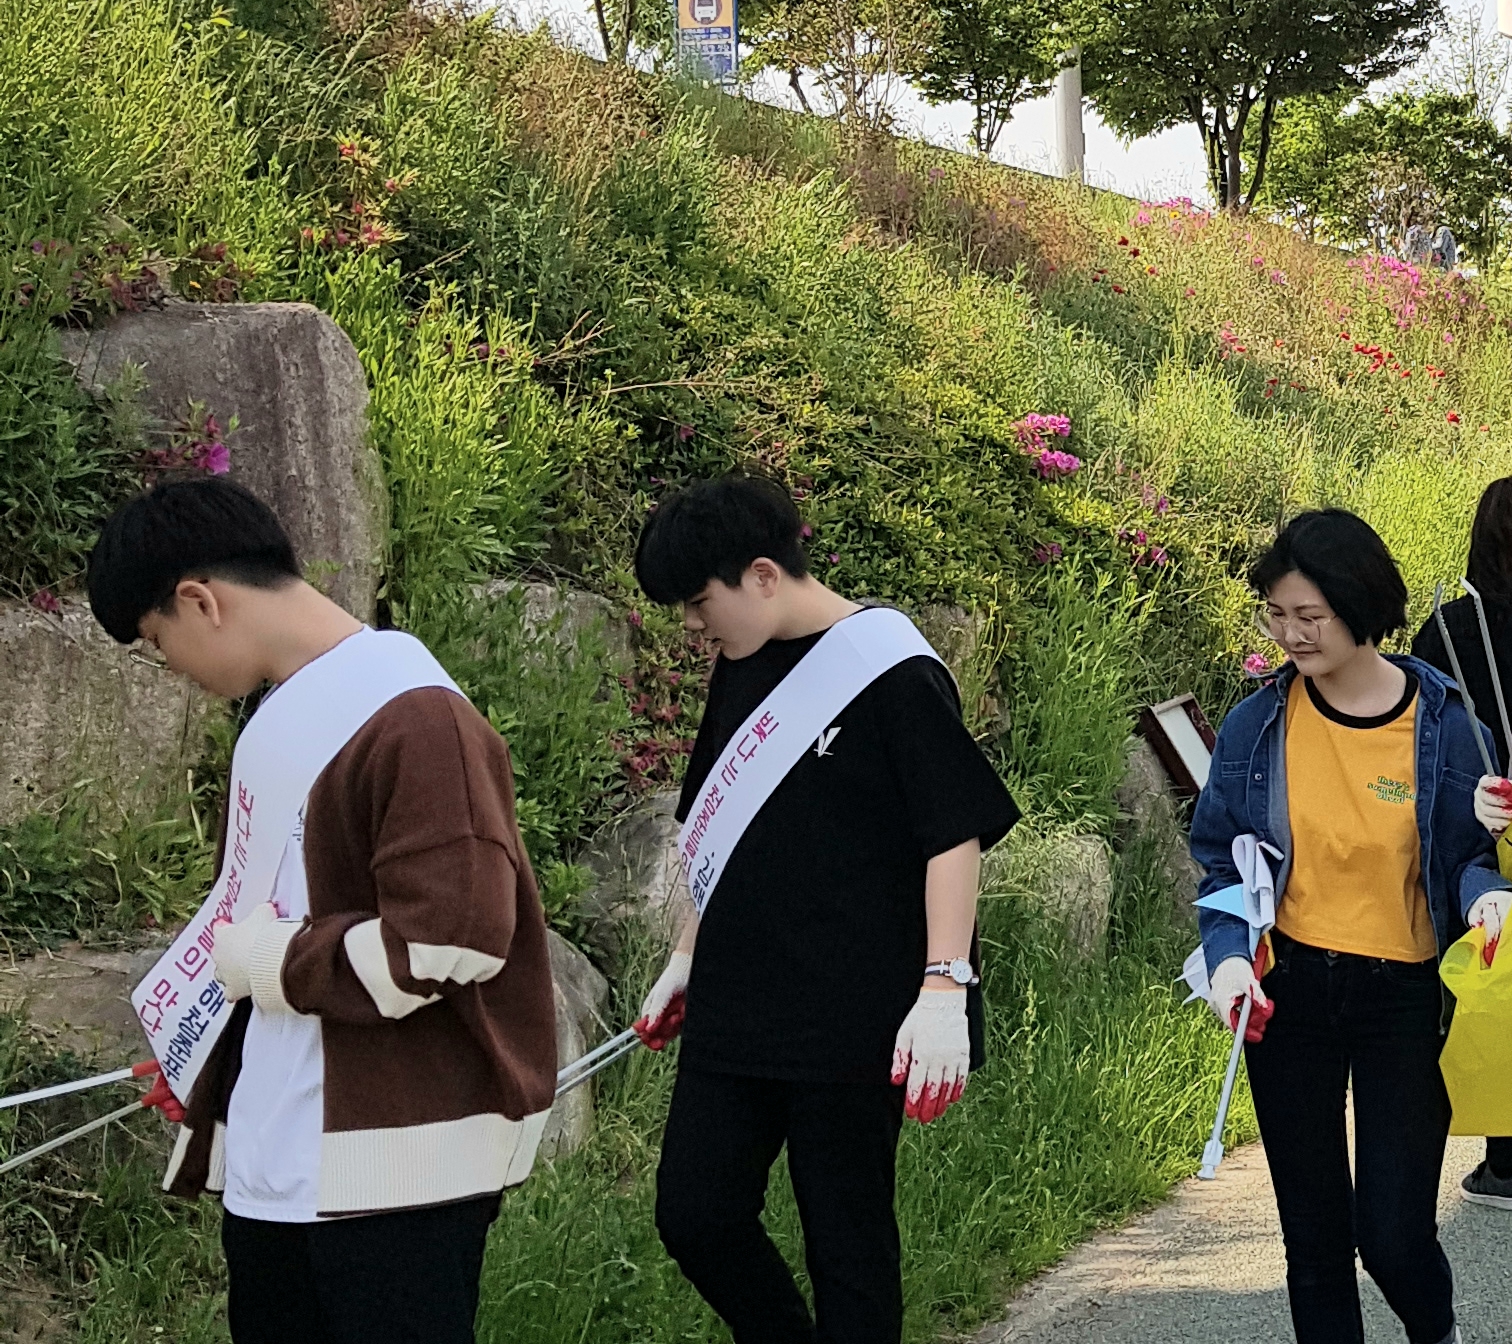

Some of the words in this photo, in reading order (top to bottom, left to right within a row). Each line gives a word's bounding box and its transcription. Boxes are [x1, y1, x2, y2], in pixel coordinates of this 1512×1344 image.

[720, 710, 780, 787] 빛나는
[139, 978, 179, 1038] 맛나
[198, 979, 226, 1018] 해
[161, 1004, 210, 1083] 청춘푸
